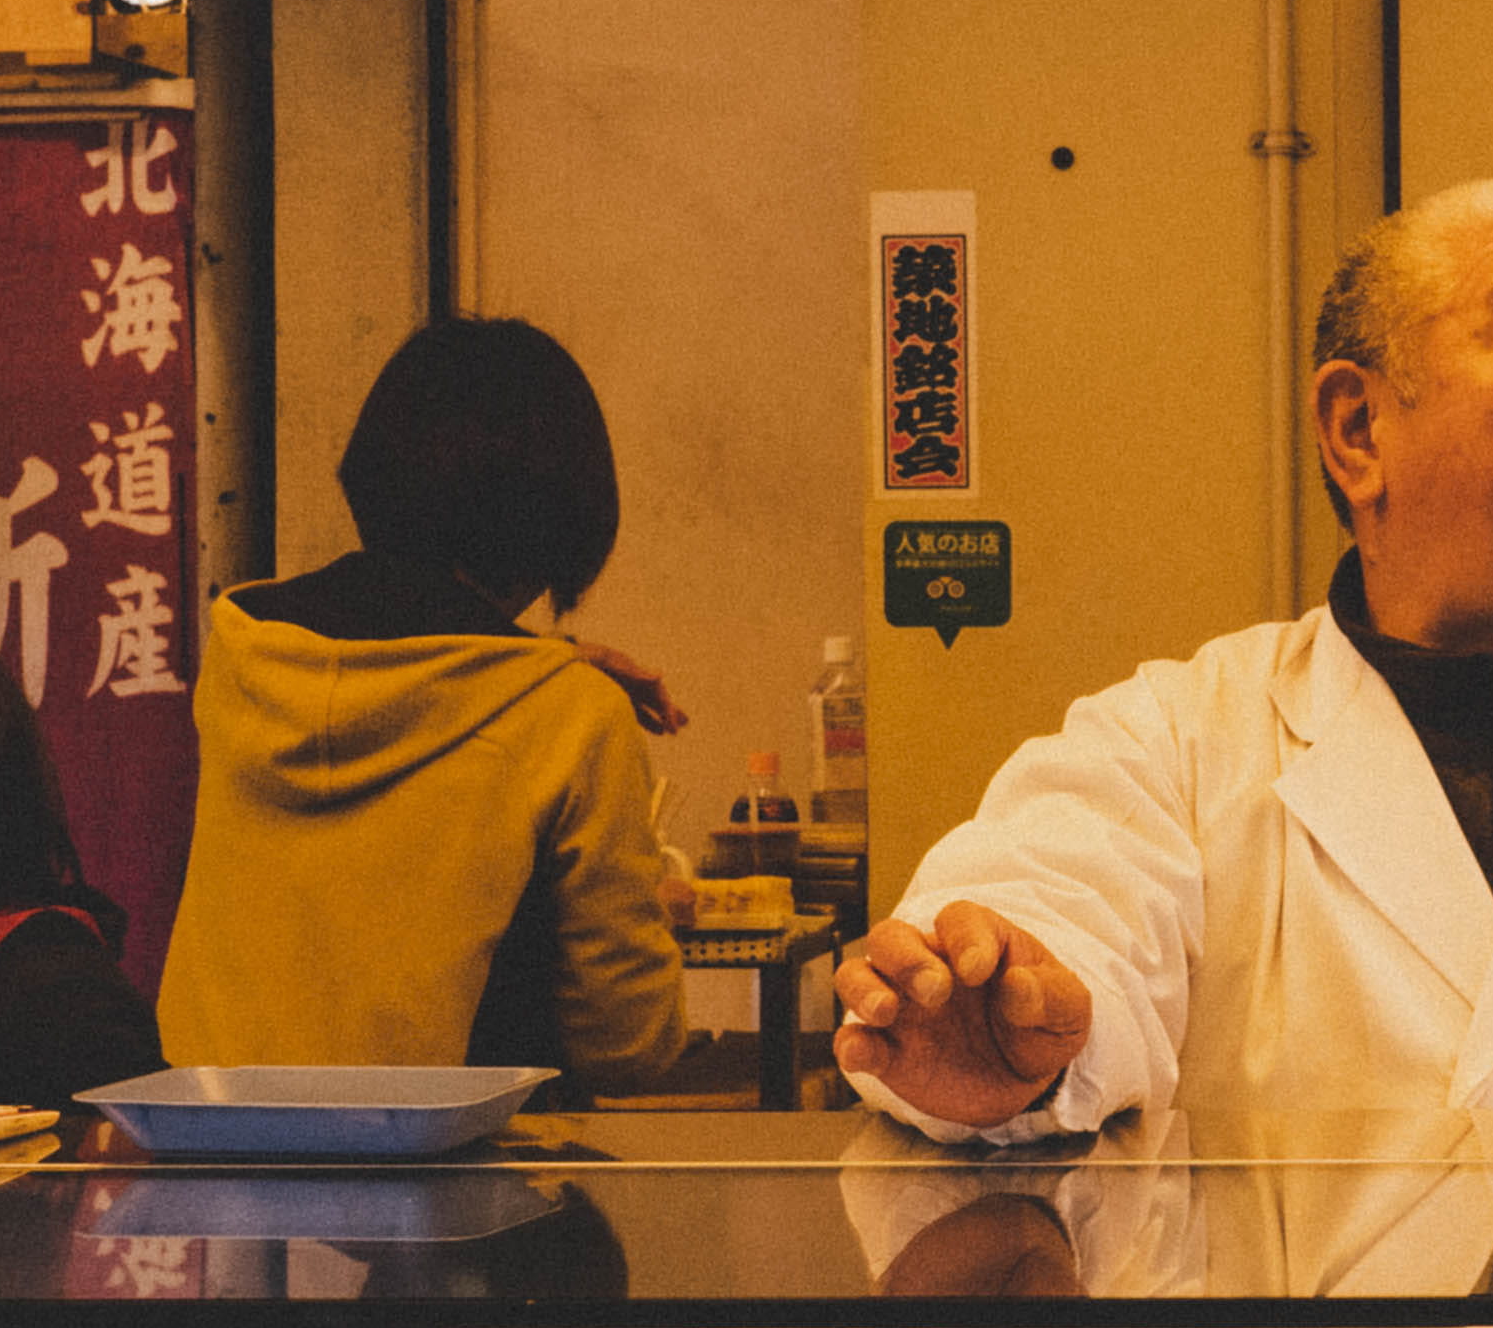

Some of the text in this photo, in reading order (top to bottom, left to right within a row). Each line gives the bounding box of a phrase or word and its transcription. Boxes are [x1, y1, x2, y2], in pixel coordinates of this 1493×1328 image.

[79, 119, 187, 702] 北海道産
[896, 531, 1000, 555] 人気のお店
